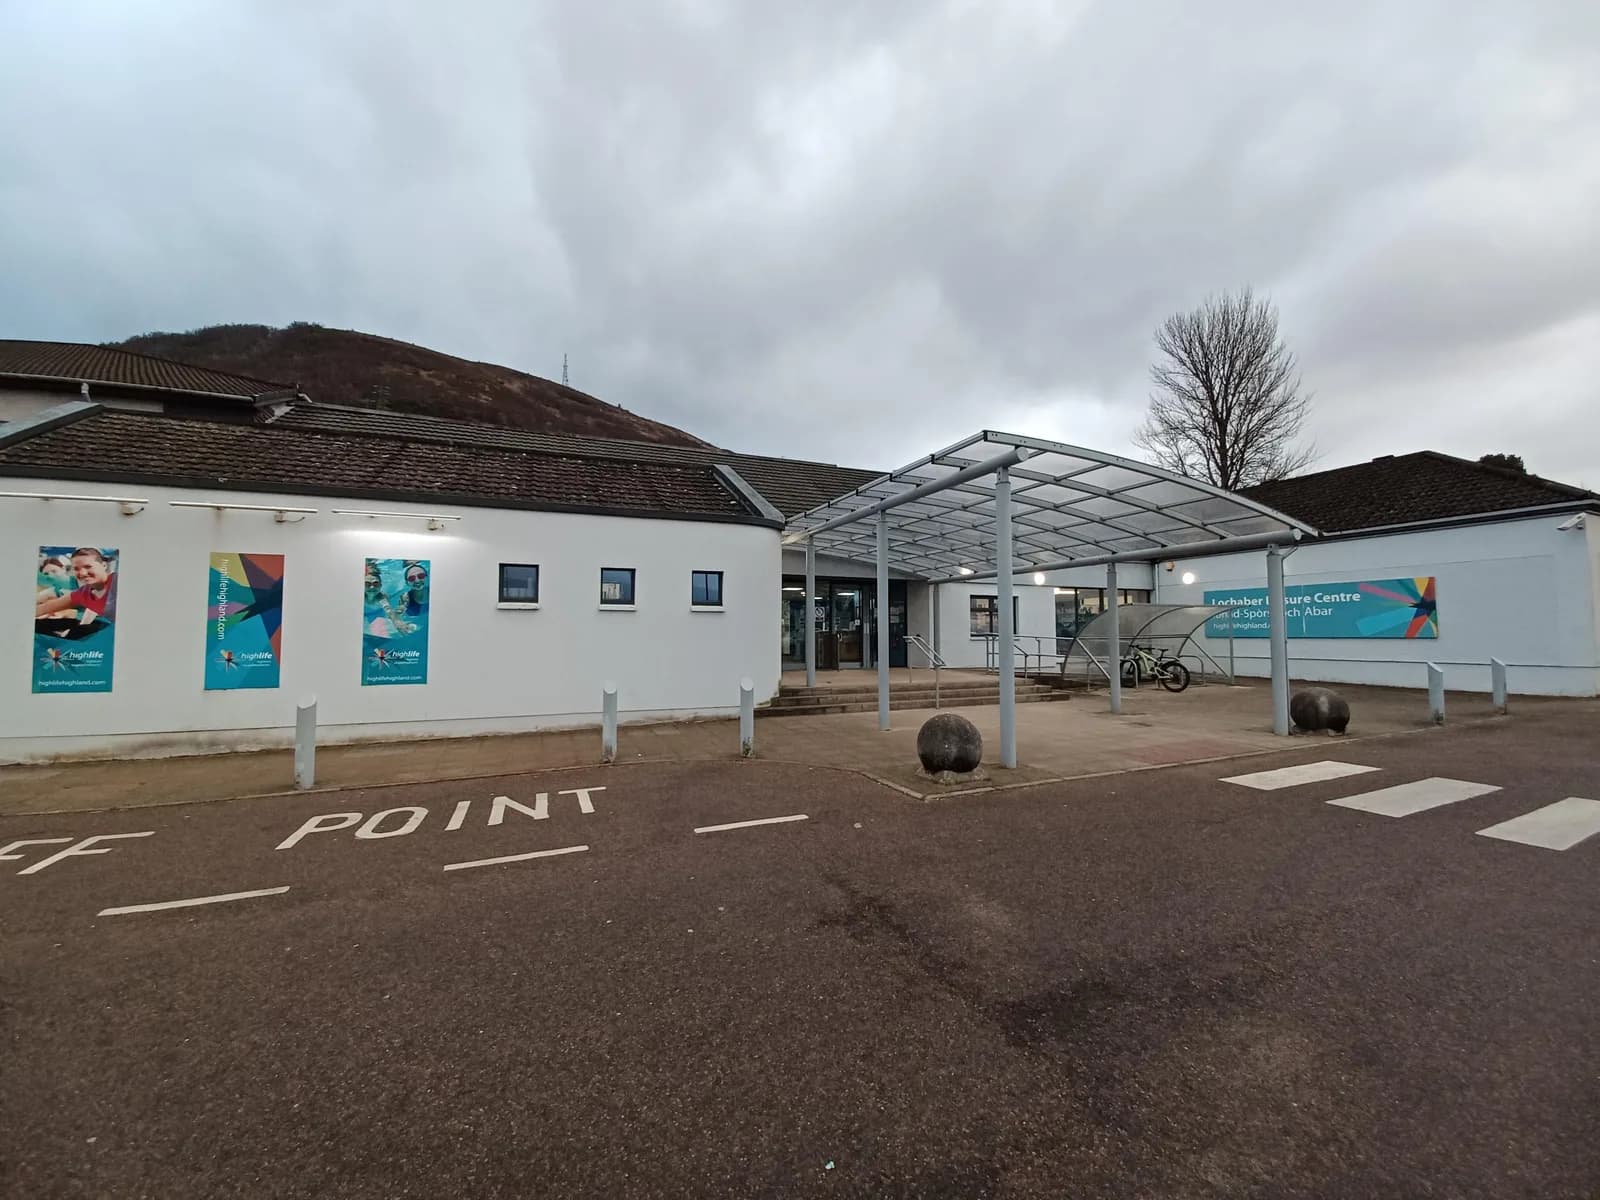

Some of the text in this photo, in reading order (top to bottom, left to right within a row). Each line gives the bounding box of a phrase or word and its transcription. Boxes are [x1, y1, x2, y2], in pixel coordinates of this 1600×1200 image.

[217, 559, 229, 640] highlifehighland.com
[1314, 592, 1361, 603] Centre
[1304, 606, 1334, 617] Abar
[69, 651, 104, 660] highlife
[241, 652, 272, 660] highlife
[392, 650, 420, 659] highlife
[275, 787, 606, 850] POINT
